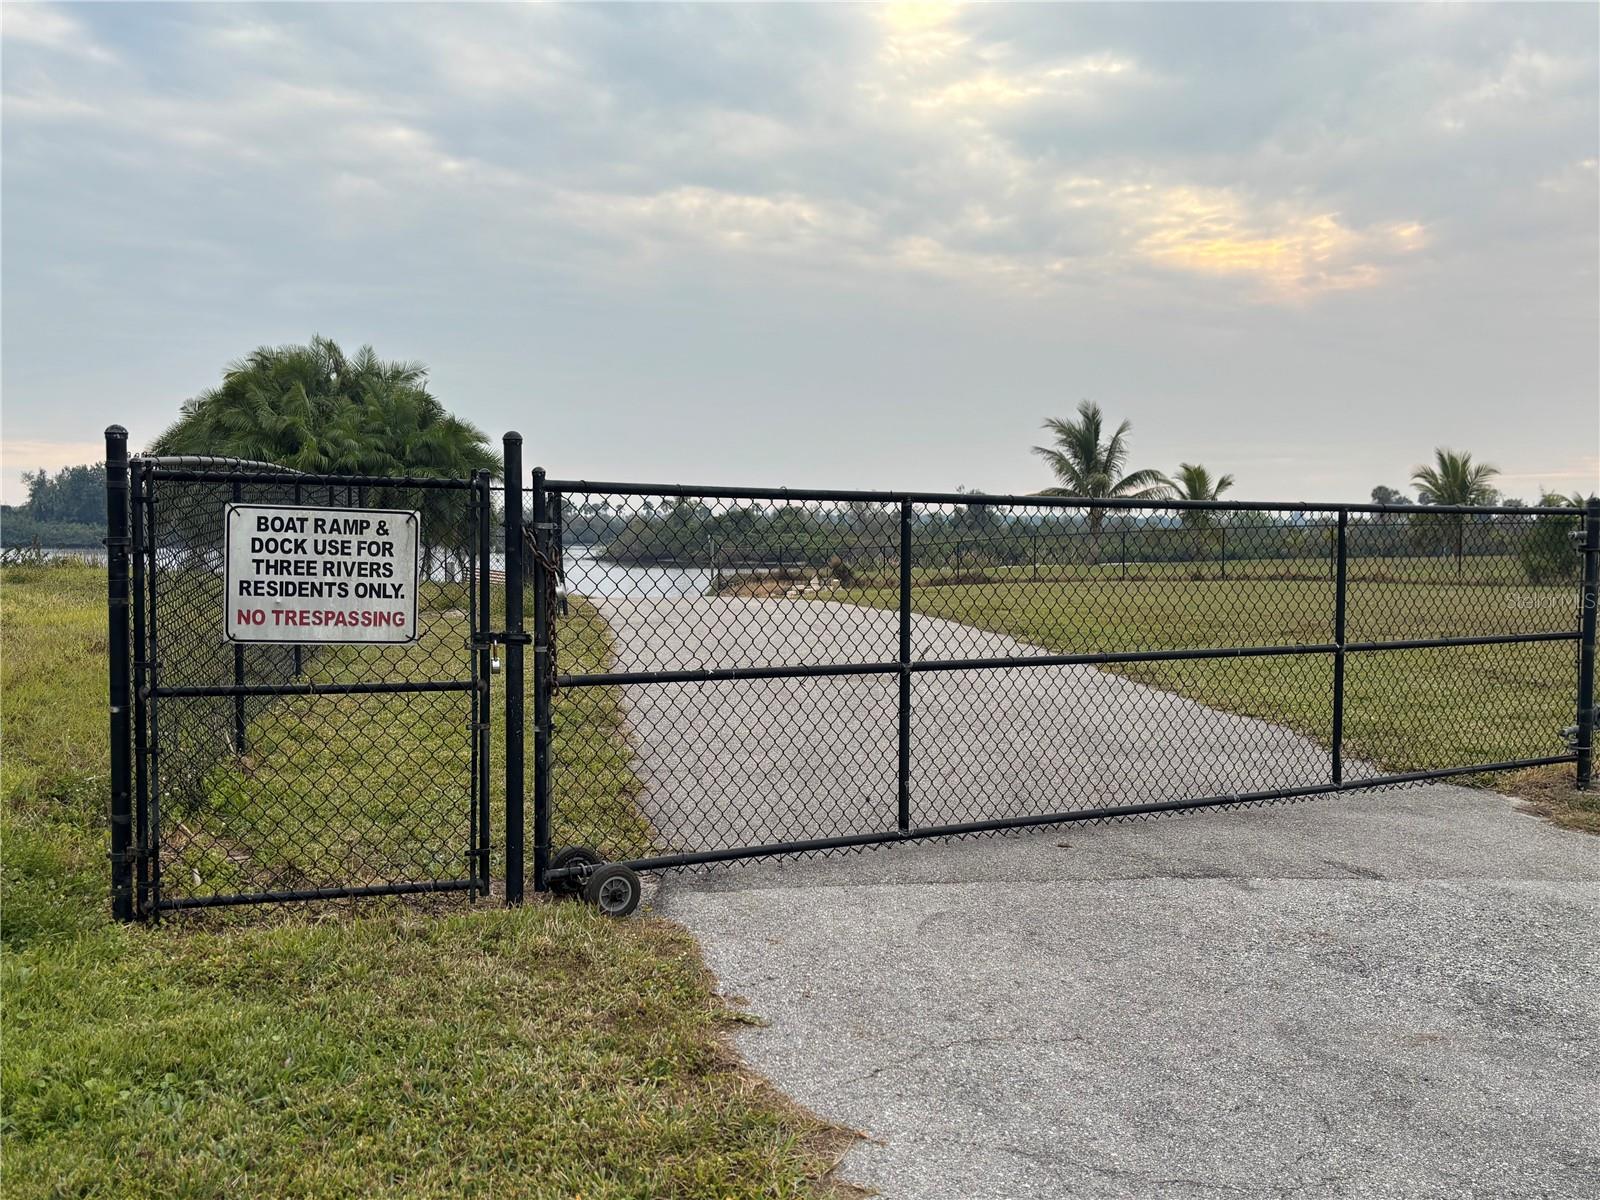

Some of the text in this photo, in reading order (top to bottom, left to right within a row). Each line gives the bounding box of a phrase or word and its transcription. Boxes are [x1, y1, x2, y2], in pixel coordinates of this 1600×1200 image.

[257, 516, 389, 536] BOAT RAMP &
[251, 538, 394, 557] DOCK USE FOR
[252, 559, 393, 578] THREE RIVERS
[239, 580, 404, 599] RESIDENTS ONLY.
[237, 609, 405, 627] NO TRESPASSING
